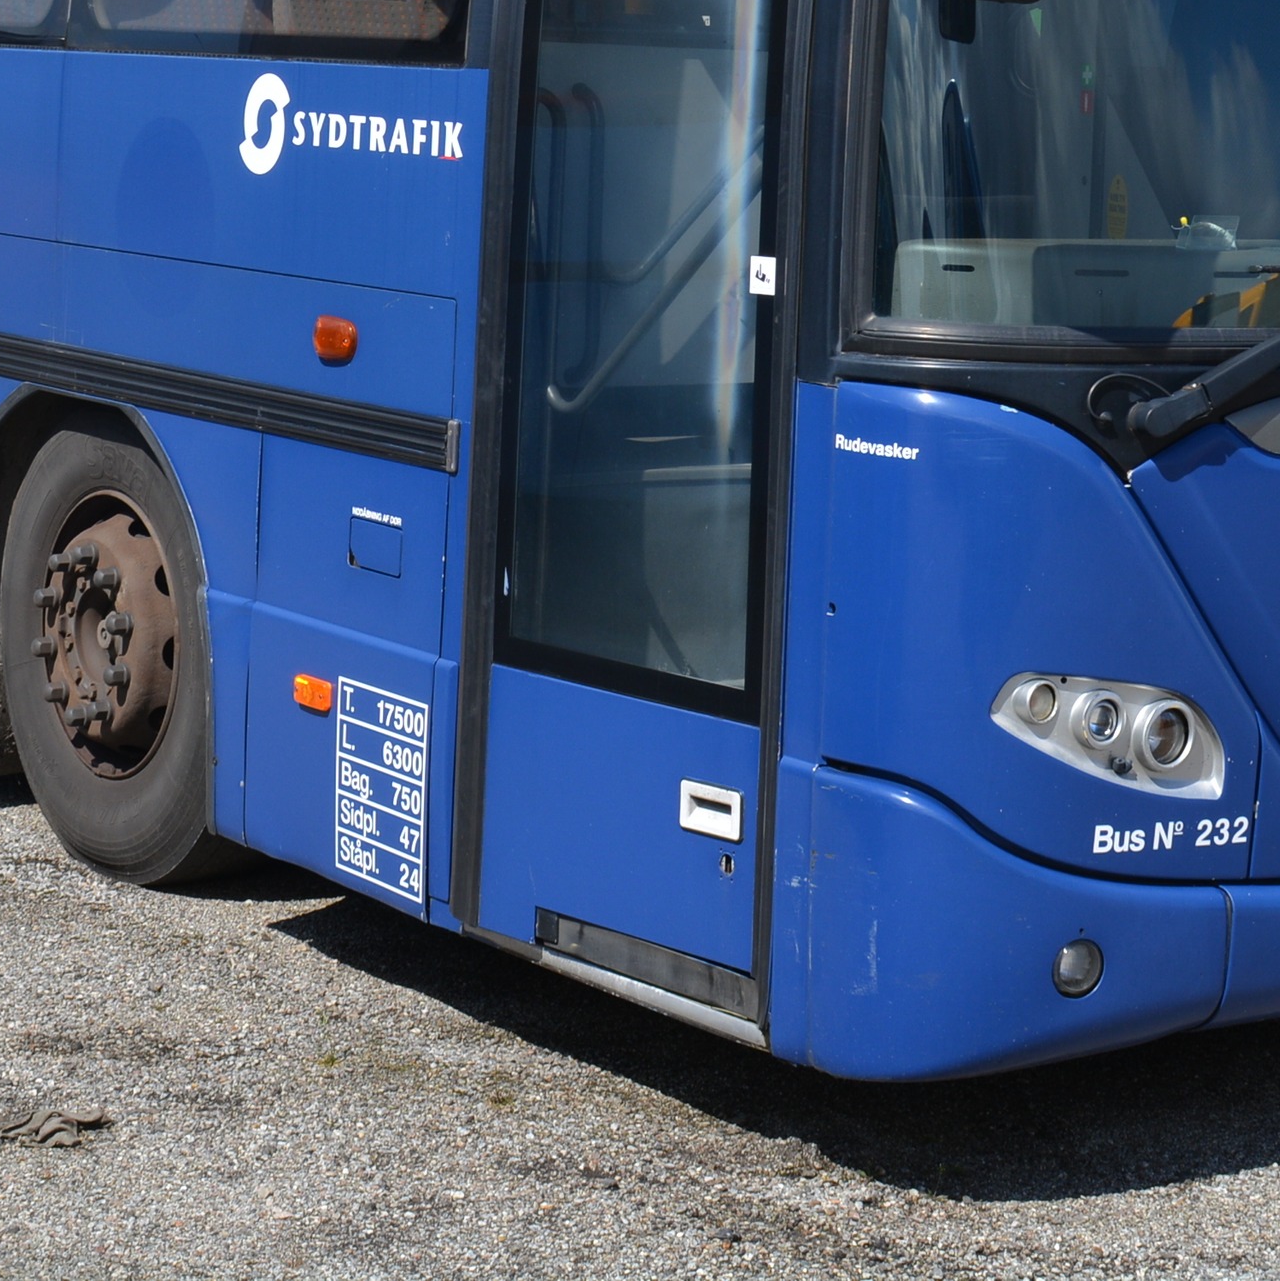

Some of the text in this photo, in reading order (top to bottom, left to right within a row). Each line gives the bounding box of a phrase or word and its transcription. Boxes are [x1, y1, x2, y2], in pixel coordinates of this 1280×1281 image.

[291, 110, 464, 160] SYDTRAFIK
[835, 433, 919, 460] Rudevasker
[343, 685, 424, 738] T. 17500
[342, 723, 423, 777] L. 6300
[340, 761, 421, 816] Bag. 750
[340, 798, 420, 854] Sidpl. 47
[1092, 824, 1146, 854] Bus
[1194, 816, 1249, 847] 232
[340, 835, 420, 893] Ståpl. 24
